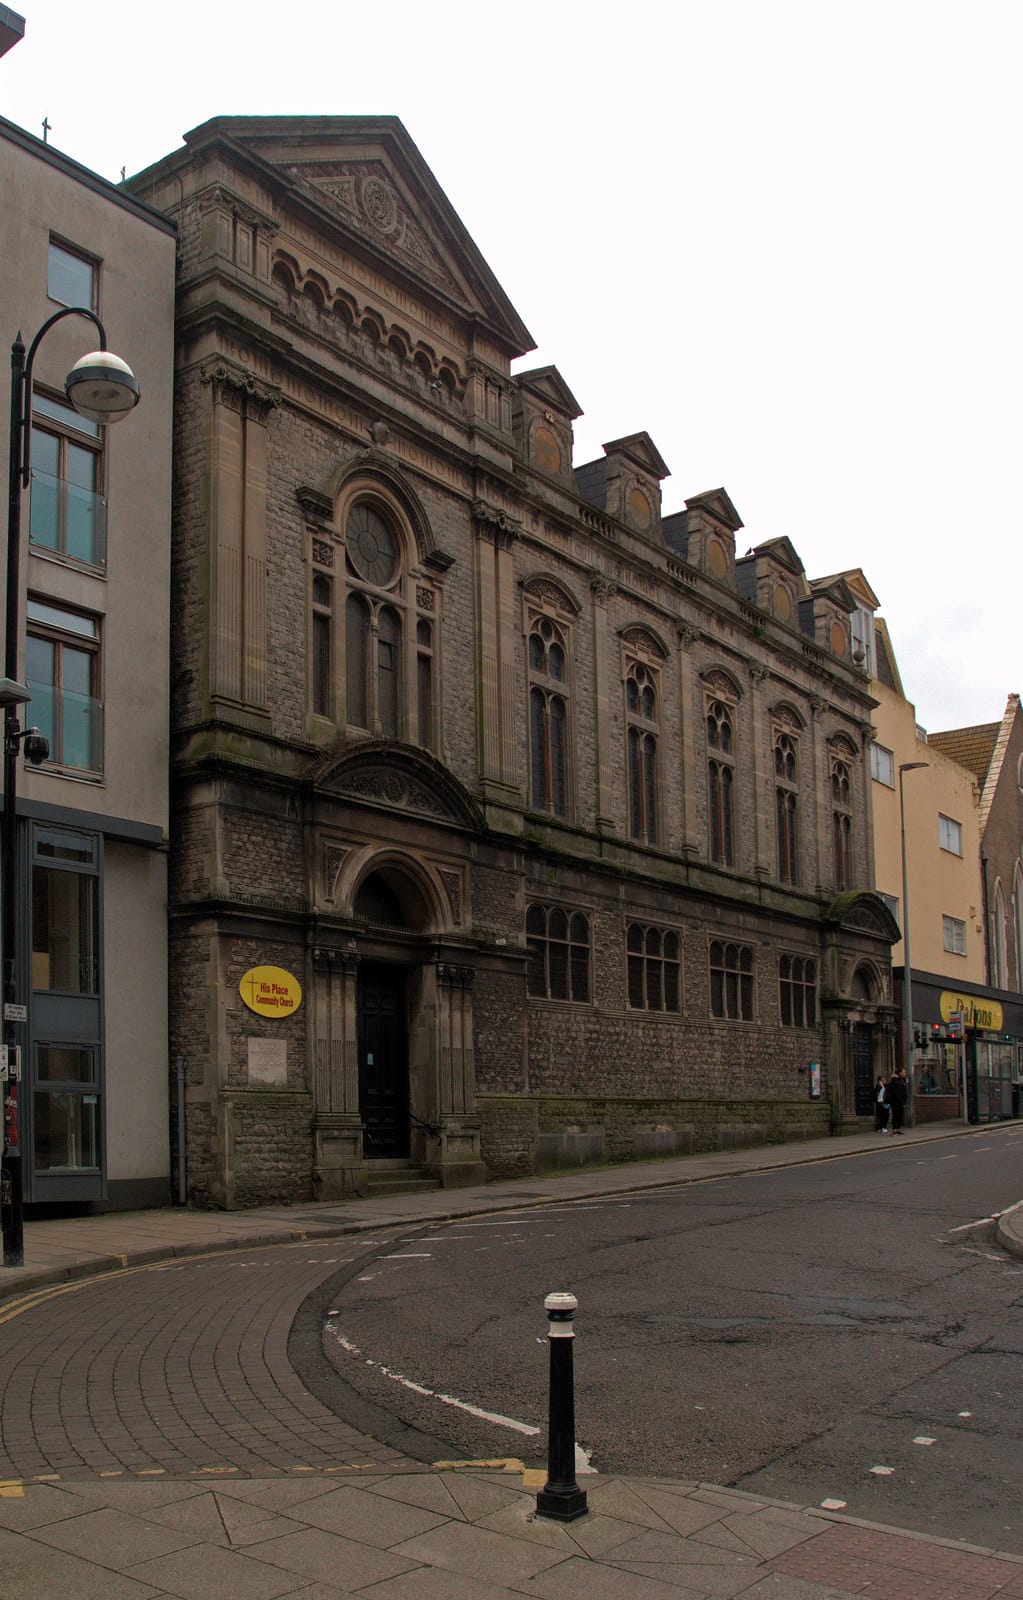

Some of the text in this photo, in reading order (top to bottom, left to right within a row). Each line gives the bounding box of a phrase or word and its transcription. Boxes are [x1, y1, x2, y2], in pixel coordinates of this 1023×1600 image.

[260, 982, 289, 996] His Place
[256, 994, 294, 1009] Community Church
[956, 998, 993, 1027] Dalons
